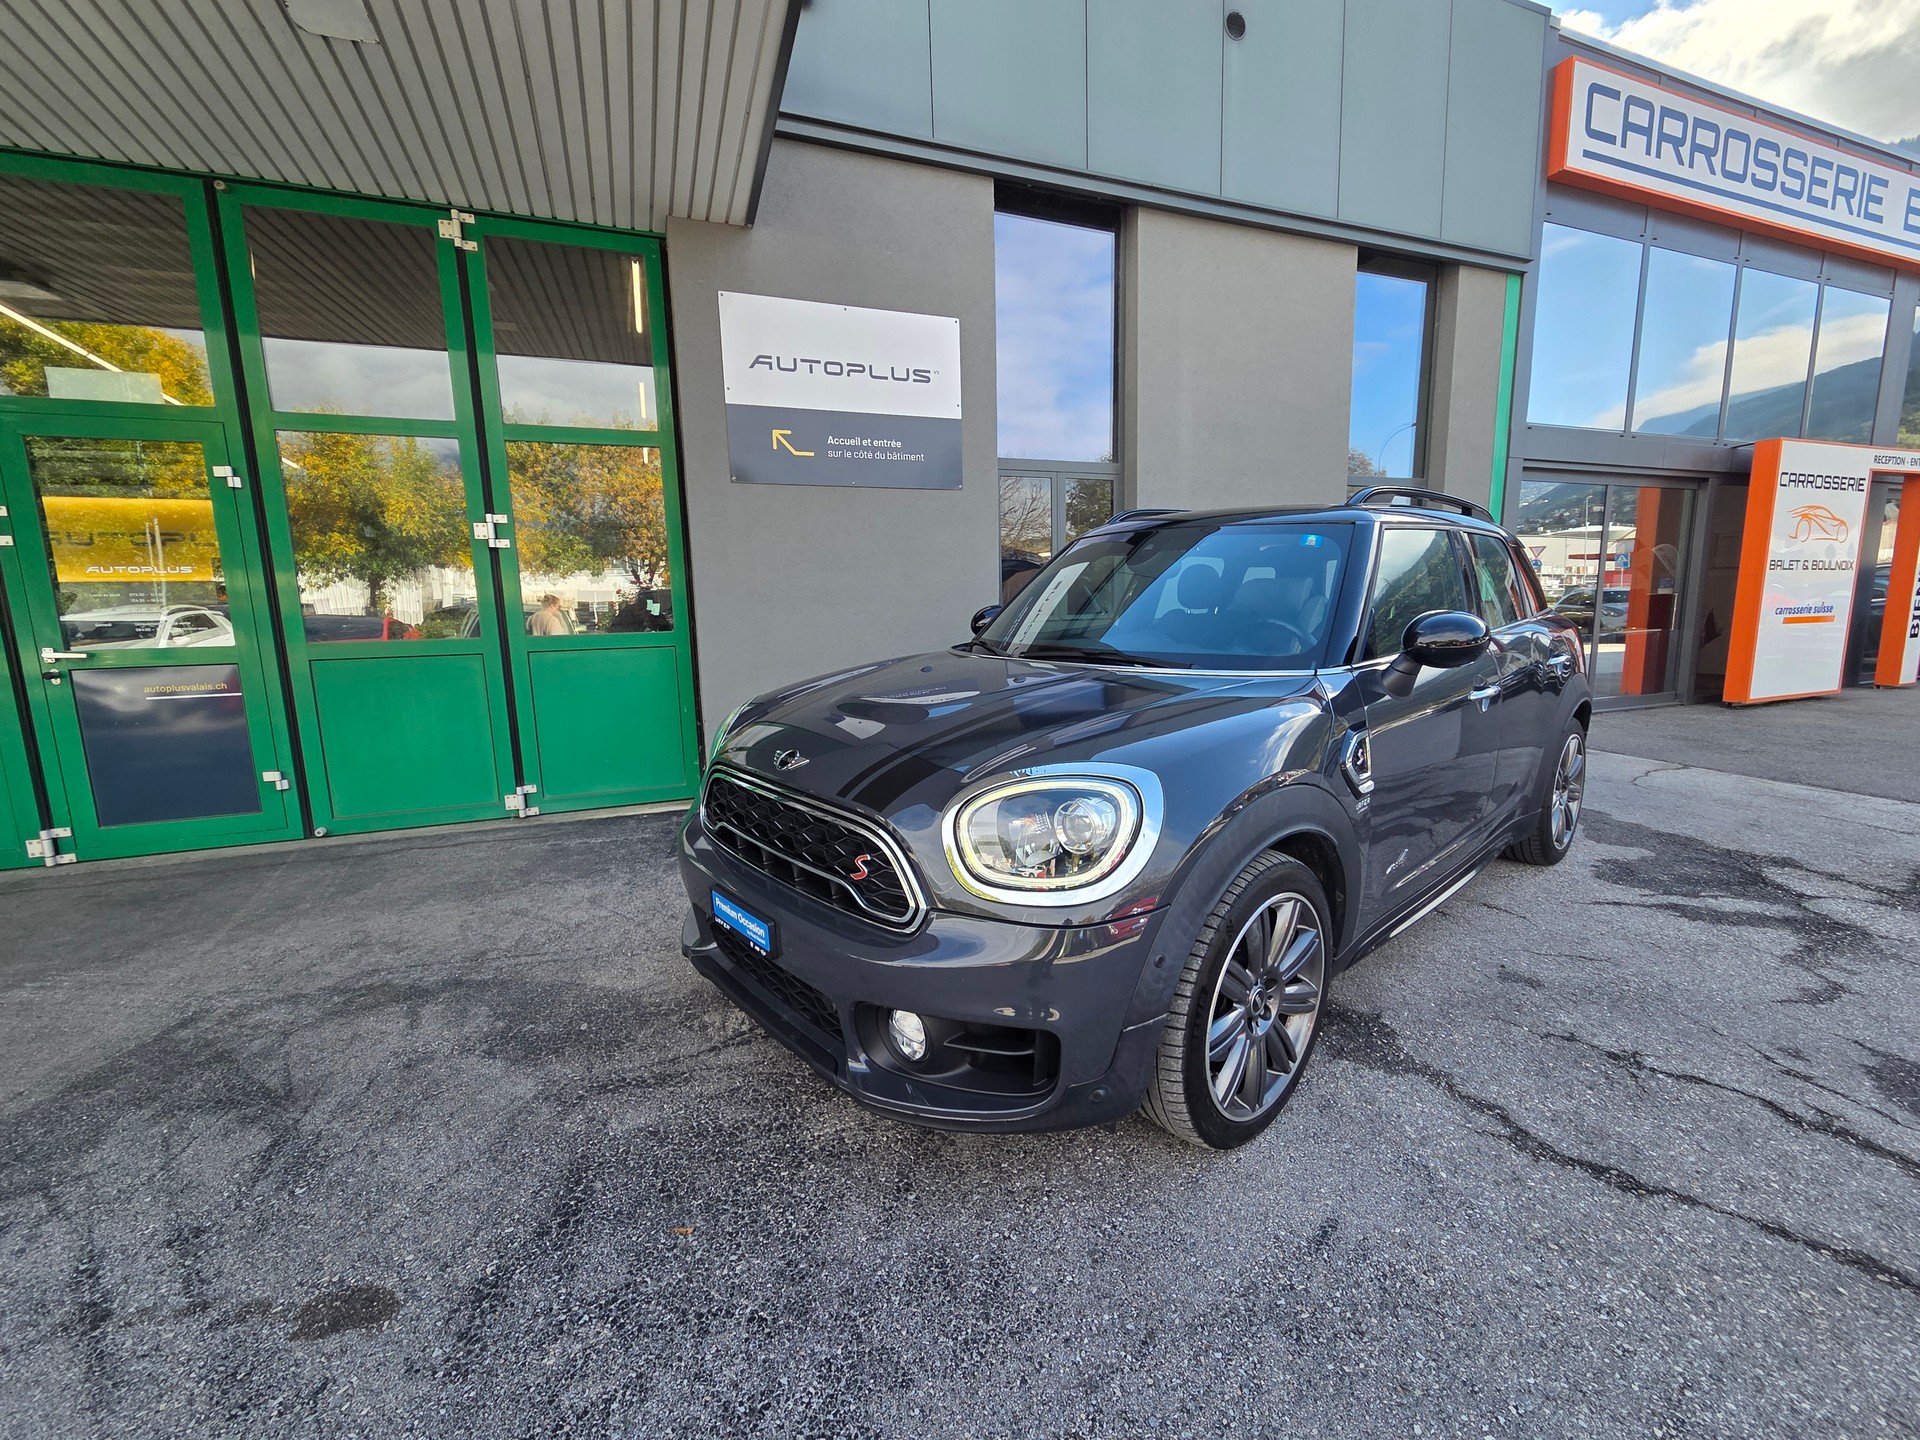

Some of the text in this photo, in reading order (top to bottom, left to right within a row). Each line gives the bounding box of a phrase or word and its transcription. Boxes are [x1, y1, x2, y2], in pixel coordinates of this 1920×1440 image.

[1585, 82, 1889, 224] CARROSSERIE
[749, 354, 931, 384] AUTOPLUS
[827, 435, 902, 448] Accueil et entrée
[827, 449, 925, 462] sur le côté du bâtiment
[1780, 472, 1867, 492] CARROSSERIE
[84, 566, 194, 574] AUTOPLUS
[1769, 559, 1855, 571] BALET & BOULNOIX
[1775, 601, 1834, 615] carrosserie suisse
[143, 682, 228, 694] autoplusvalais.ch
[715, 896, 738, 920] Premium
[737, 913, 765, 938] Occasion
